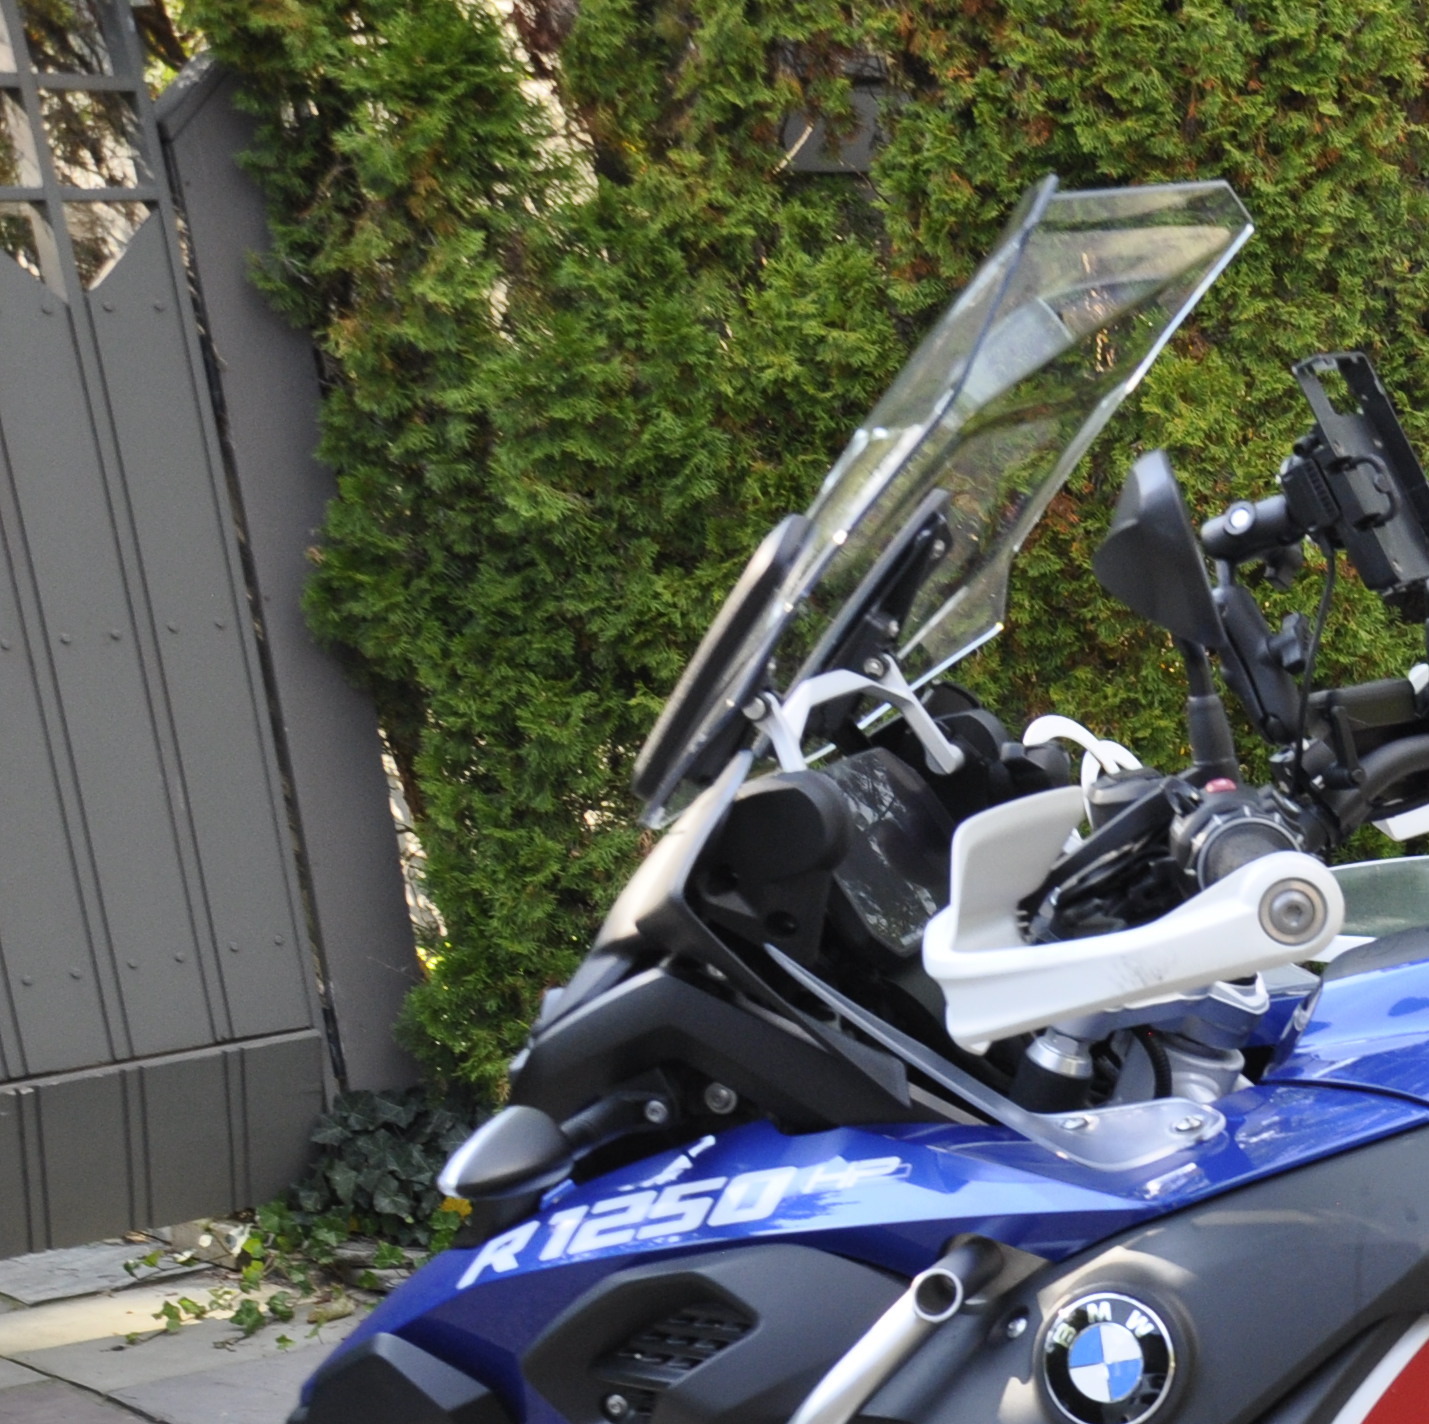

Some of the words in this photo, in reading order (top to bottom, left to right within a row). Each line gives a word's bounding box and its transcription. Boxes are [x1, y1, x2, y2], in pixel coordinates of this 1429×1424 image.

[455, 1220, 540, 1291] R
[538, 1167, 798, 1262] 1250
[1054, 1301, 1154, 1347] BMW
